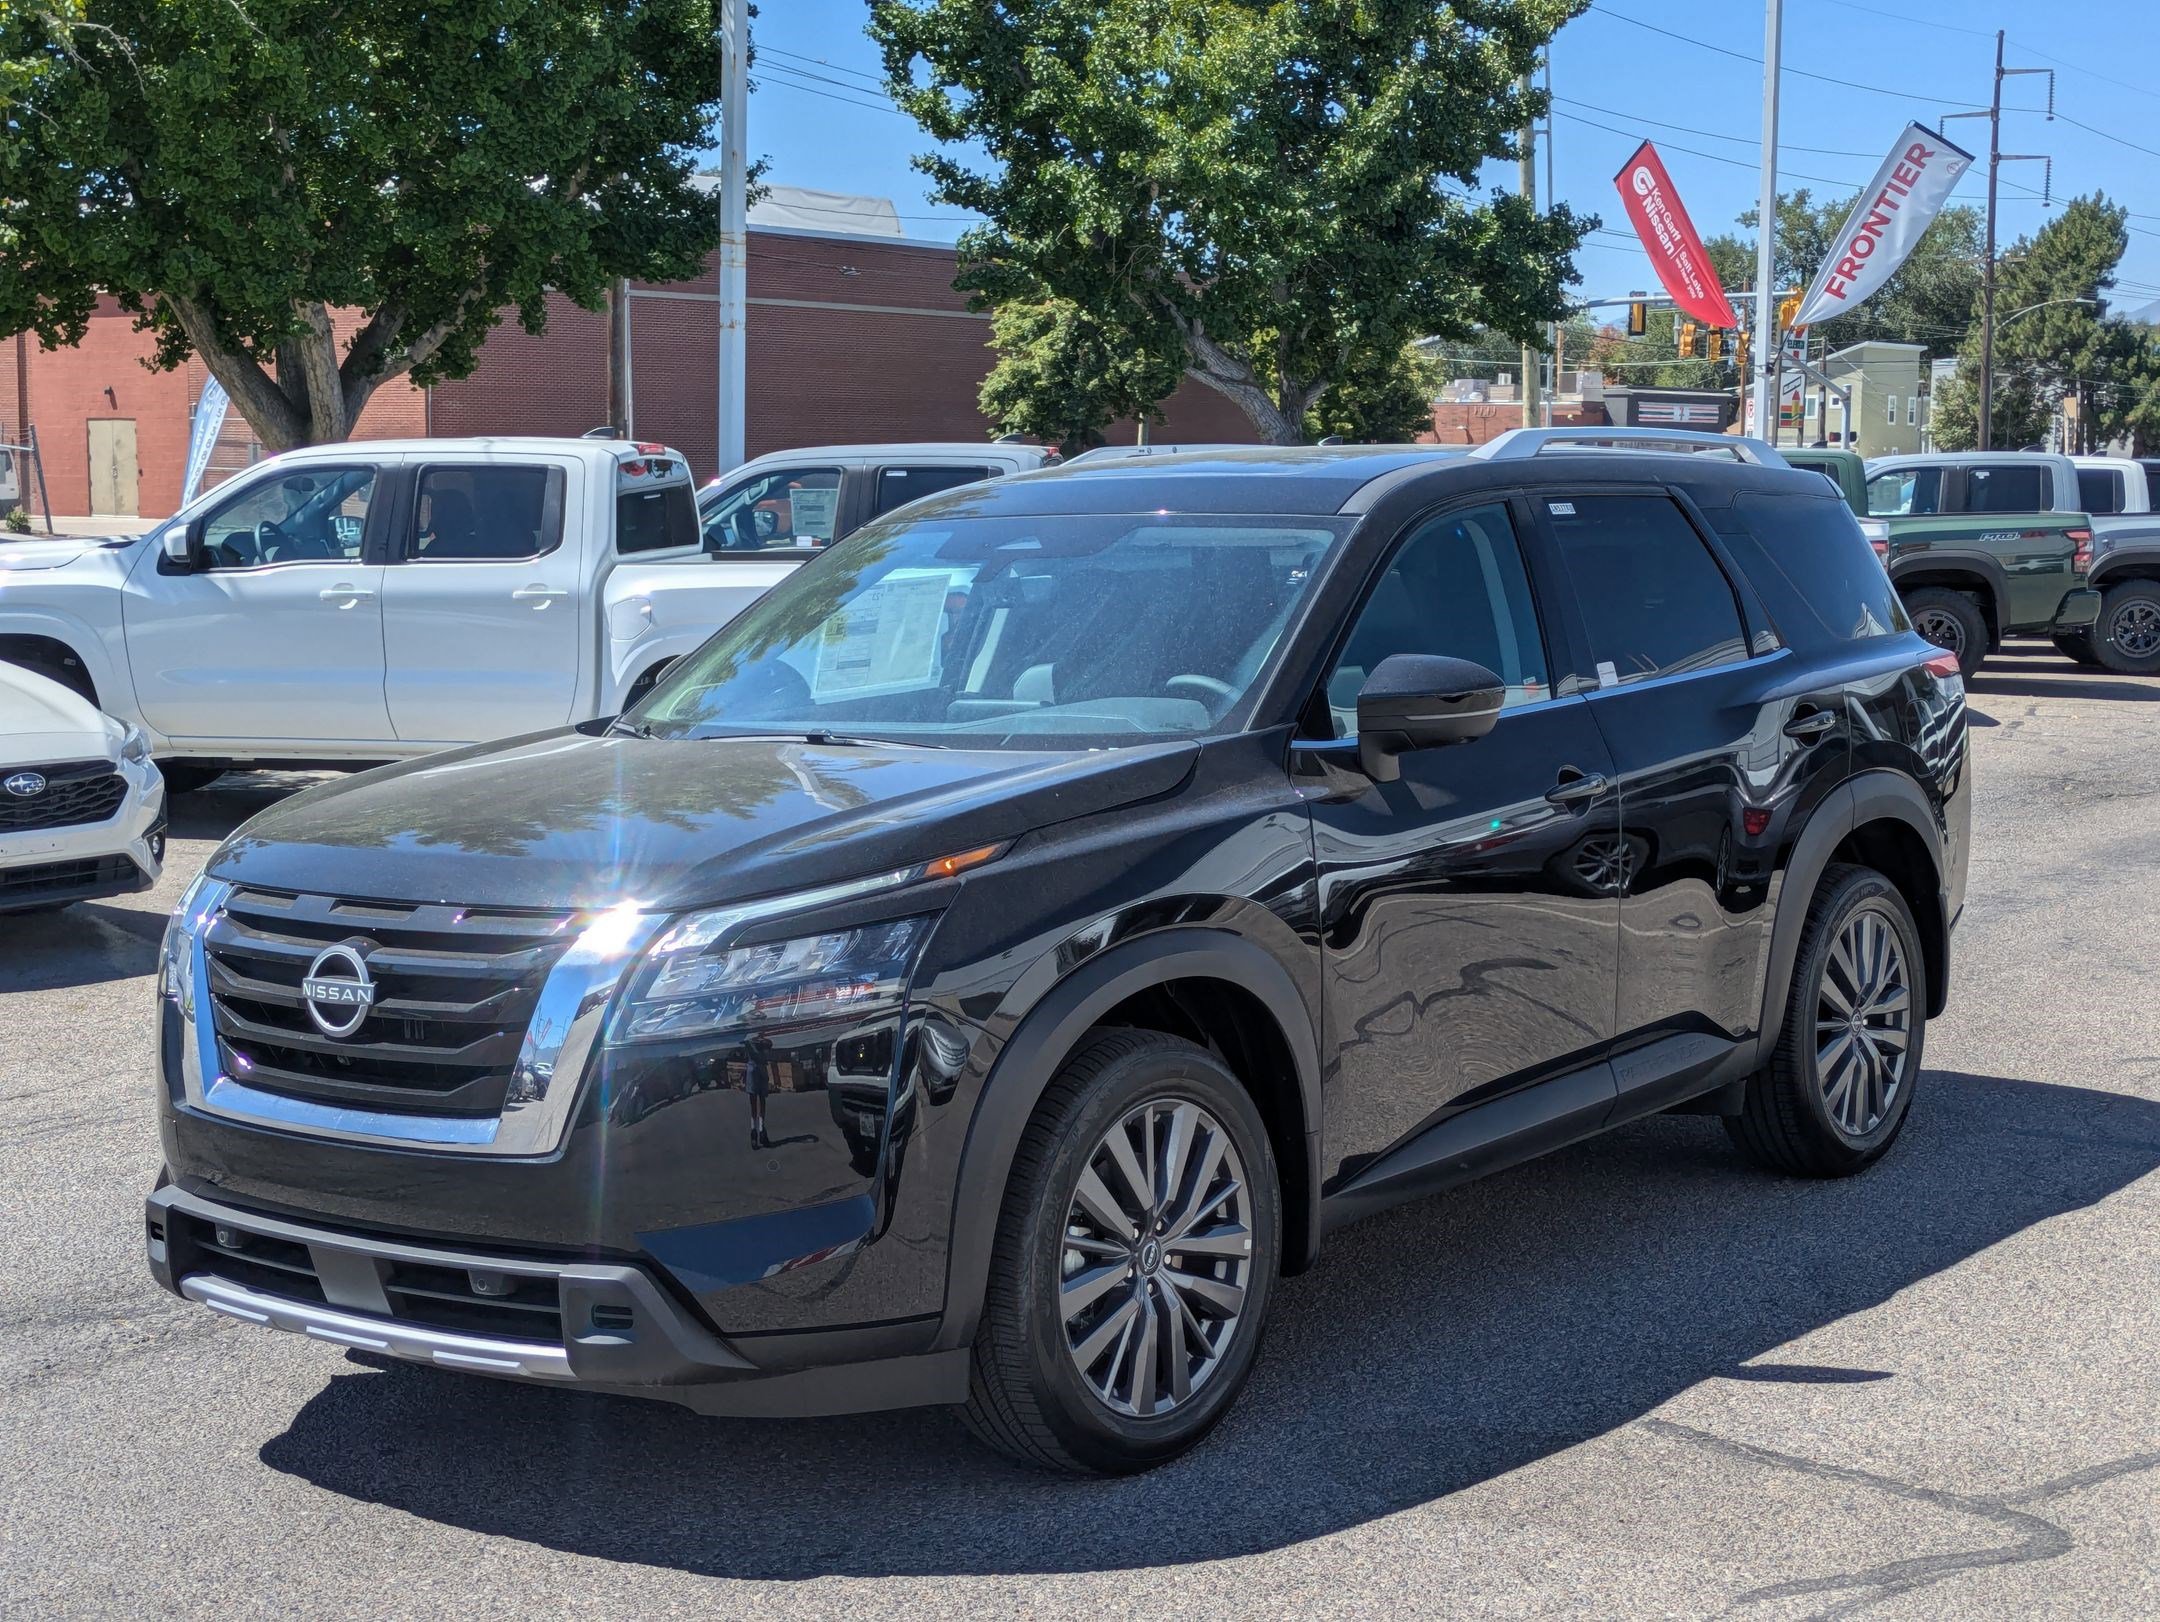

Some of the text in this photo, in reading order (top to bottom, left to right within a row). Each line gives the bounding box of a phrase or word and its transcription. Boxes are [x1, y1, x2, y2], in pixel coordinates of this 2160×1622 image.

[1642, 195, 1675, 256] Nissan
[1651, 187, 1682, 241] Ken Garff
[1824, 143, 1936, 300] FRONTIER
[1679, 251, 1704, 300] Salt Lake
[303, 982, 371, 1002] NISSAN
